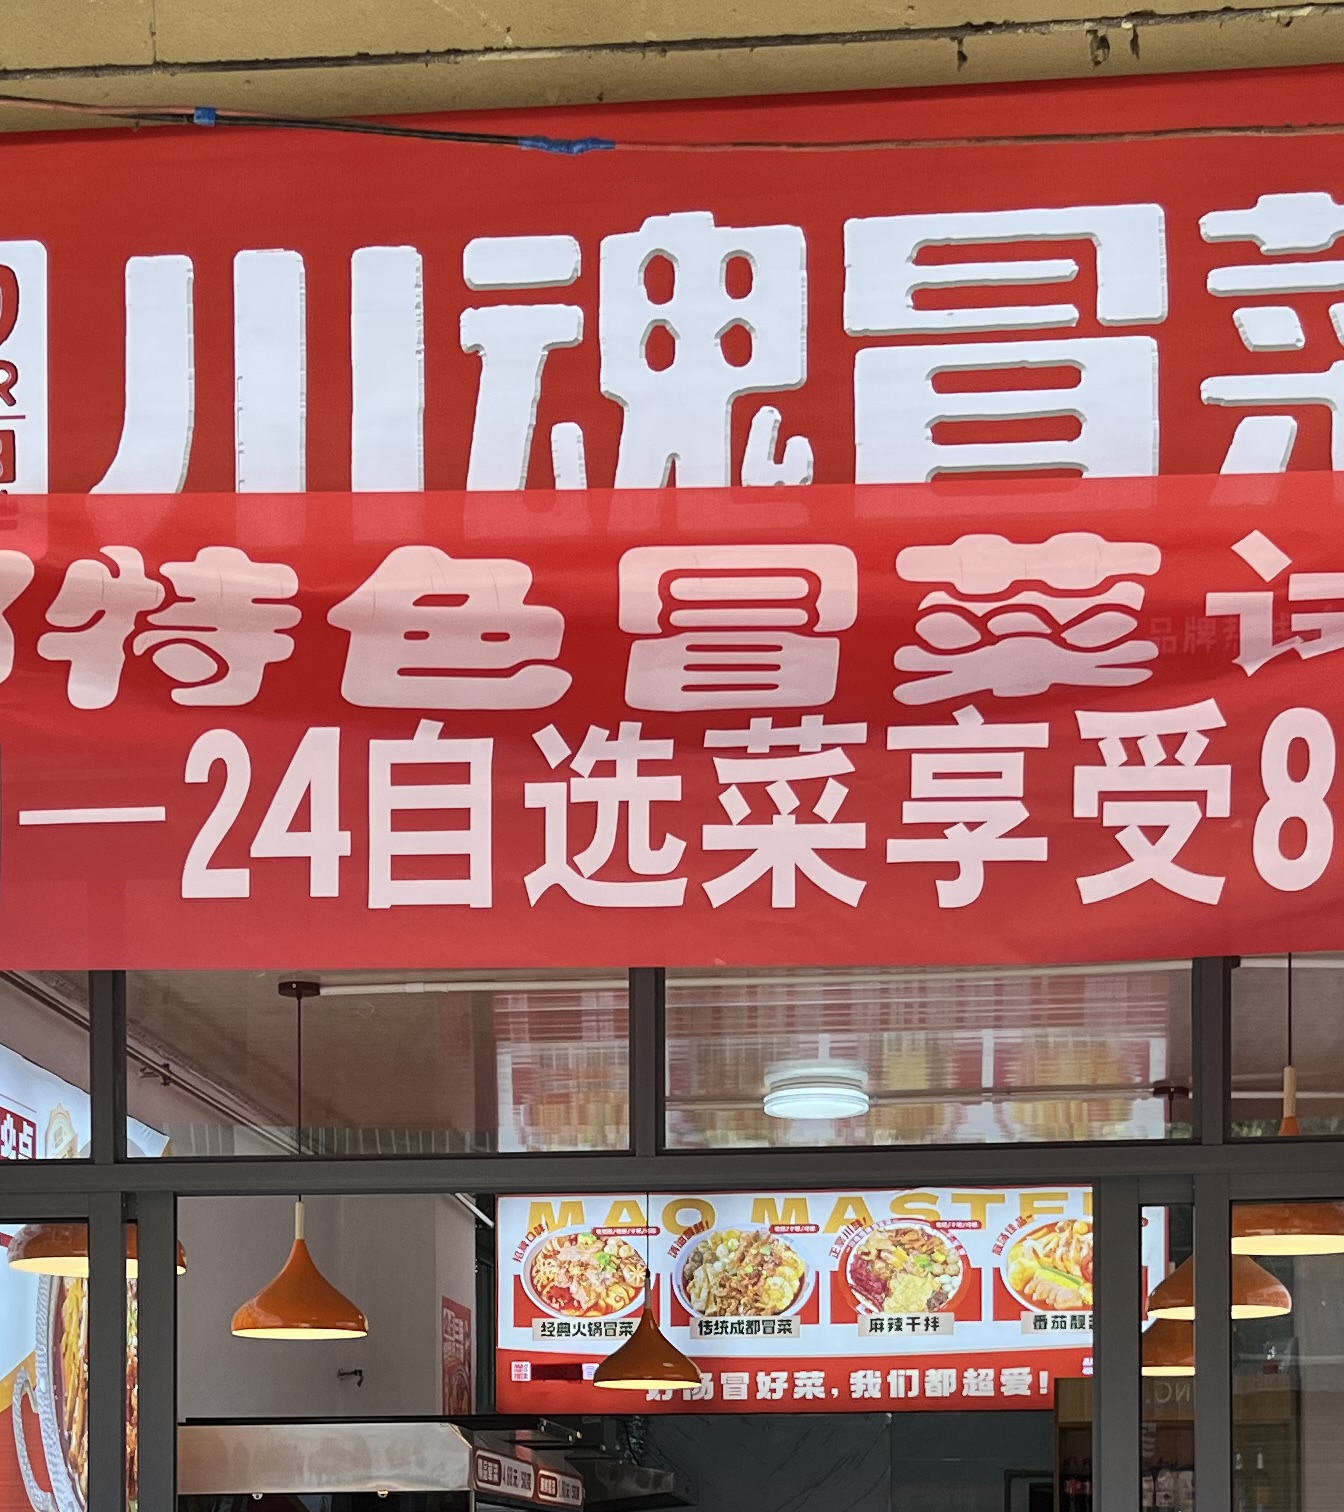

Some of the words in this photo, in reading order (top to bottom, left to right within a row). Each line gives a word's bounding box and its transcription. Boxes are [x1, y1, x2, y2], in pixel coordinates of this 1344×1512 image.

[528, 1198, 716, 1235] MAO
[751, 1192, 1093, 1236] MASTE
[540, 1321, 634, 1337] 经典火锅冒菜
[698, 1319, 793, 1336] 传统成都冒菜
[869, 1317, 940, 1333] 麻辣干拌
[1033, 1315, 1093, 1331] 番茄靓
